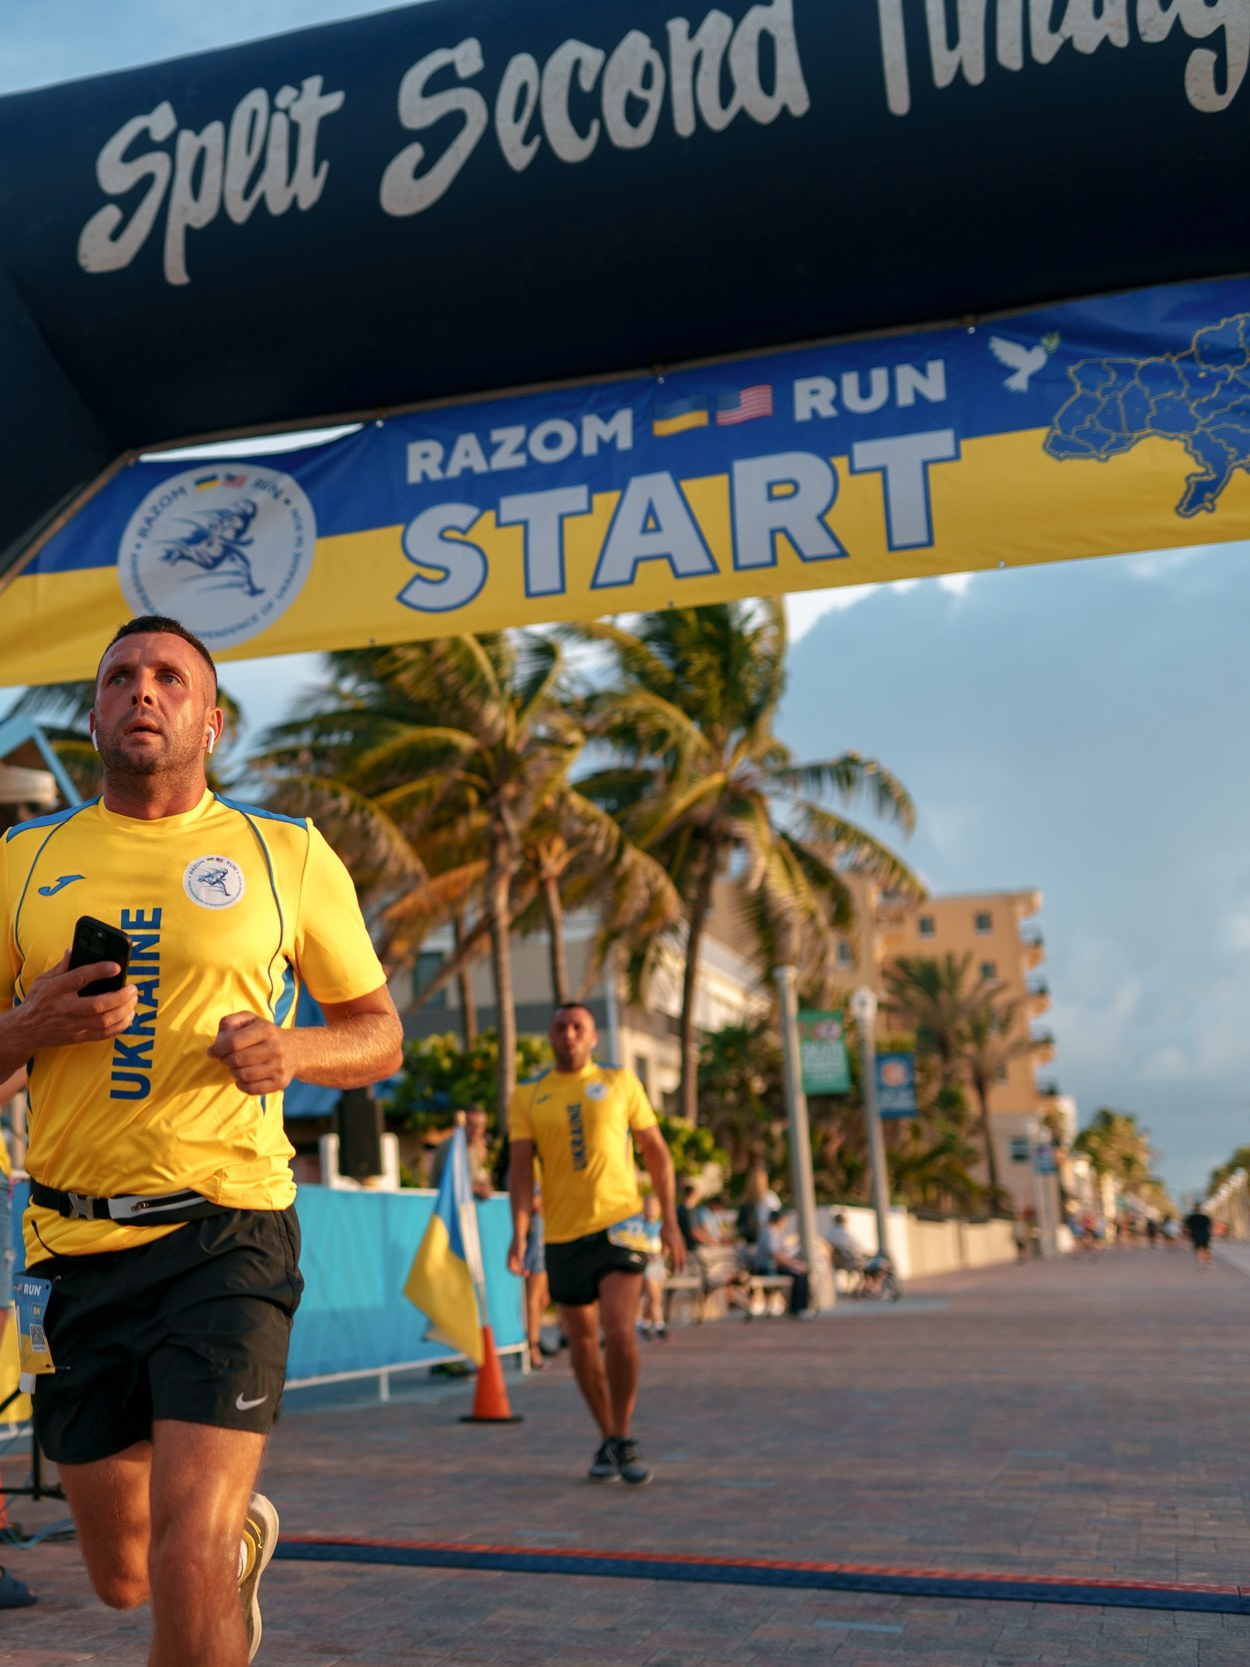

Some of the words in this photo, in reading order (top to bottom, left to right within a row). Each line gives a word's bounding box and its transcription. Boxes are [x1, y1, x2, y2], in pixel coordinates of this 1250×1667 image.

[77, 75, 345, 286] Split
[380, 0, 810, 217] Second
[406, 408, 633, 485] RAZOM
[793, 359, 947, 423] RUN
[139, 485, 187, 539] RAZOM
[396, 431, 962, 612] START
[189, 860, 205, 875] RAZOM
[226, 860, 238, 871] RUN
[23, 1283, 41, 1296] RUN
